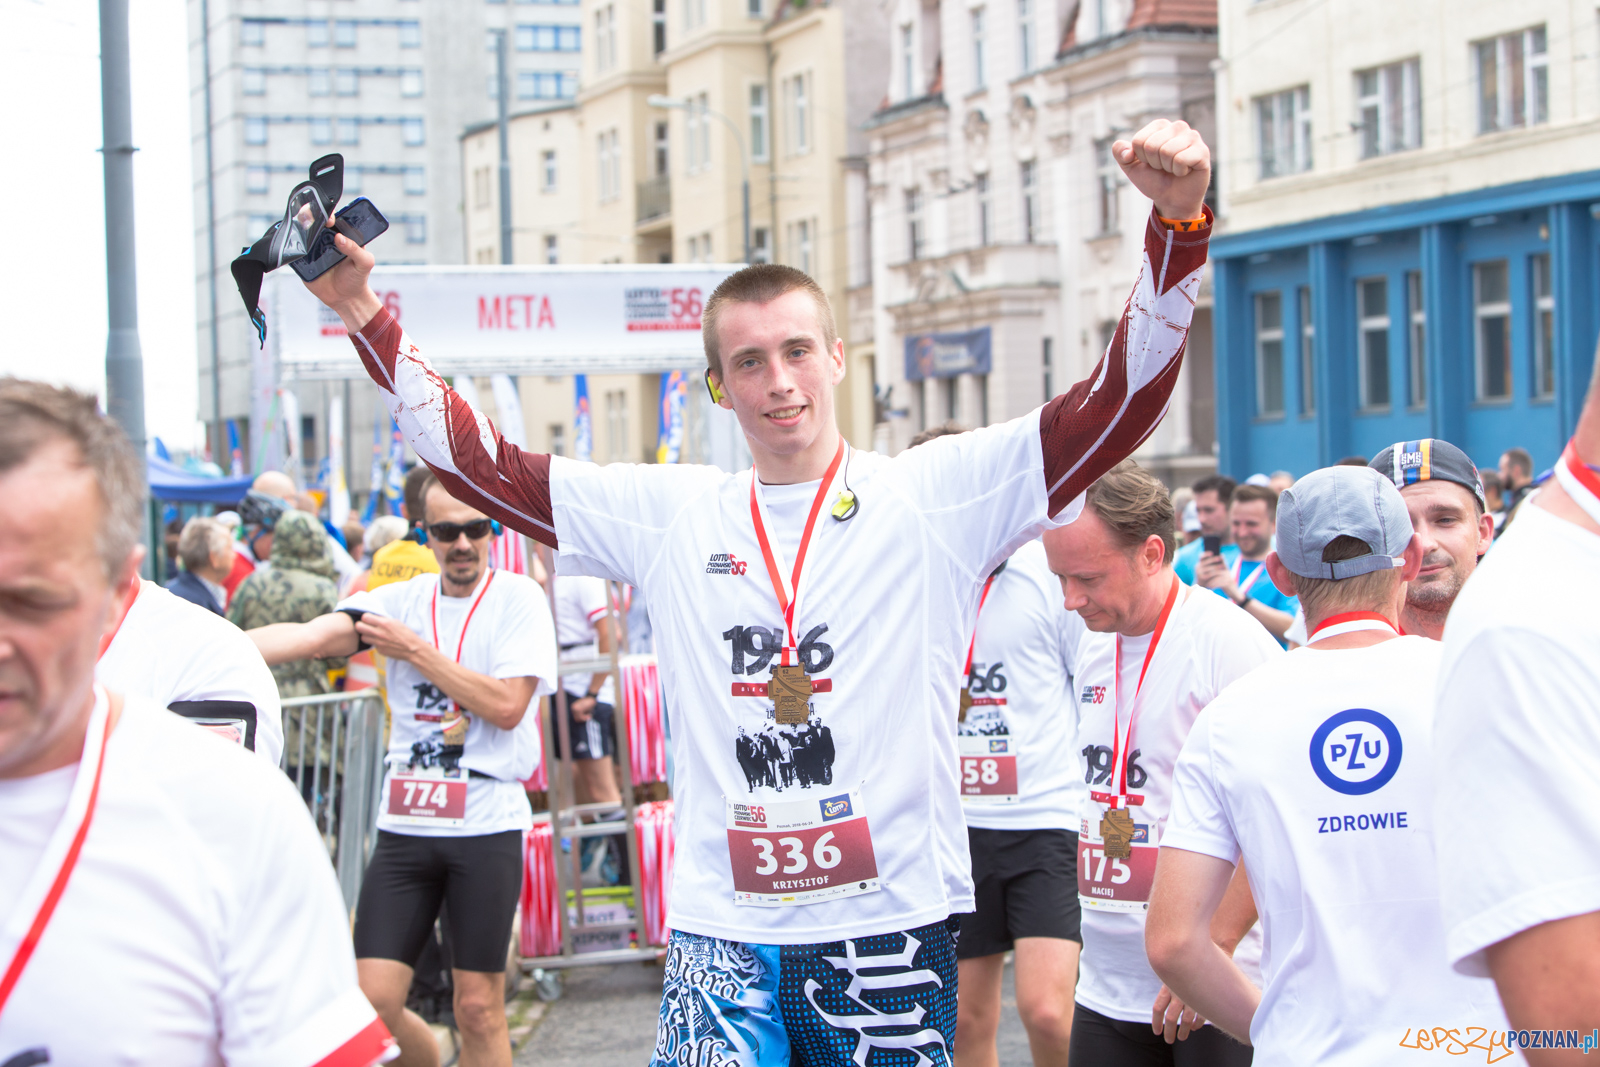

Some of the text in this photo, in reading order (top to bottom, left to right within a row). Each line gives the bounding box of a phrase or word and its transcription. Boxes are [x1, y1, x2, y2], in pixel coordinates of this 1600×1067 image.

[478, 294, 554, 329] META
[1401, 453, 1422, 465] SMS
[709, 553, 729, 561] LOTTO
[706, 567, 731, 575] CZERWIEC
[1330, 733, 1382, 770] PZU
[960, 758, 999, 785] 58
[1082, 744, 1148, 789] 196
[403, 782, 448, 809] 774
[733, 803, 748, 812] LOTTO
[1317, 812, 1408, 834] ZDROWIE
[751, 831, 842, 876] 336
[1082, 847, 1131, 885] 175
[772, 875, 830, 890] KRZYSZTOF
[1091, 886, 1114, 898] MACIEJ
